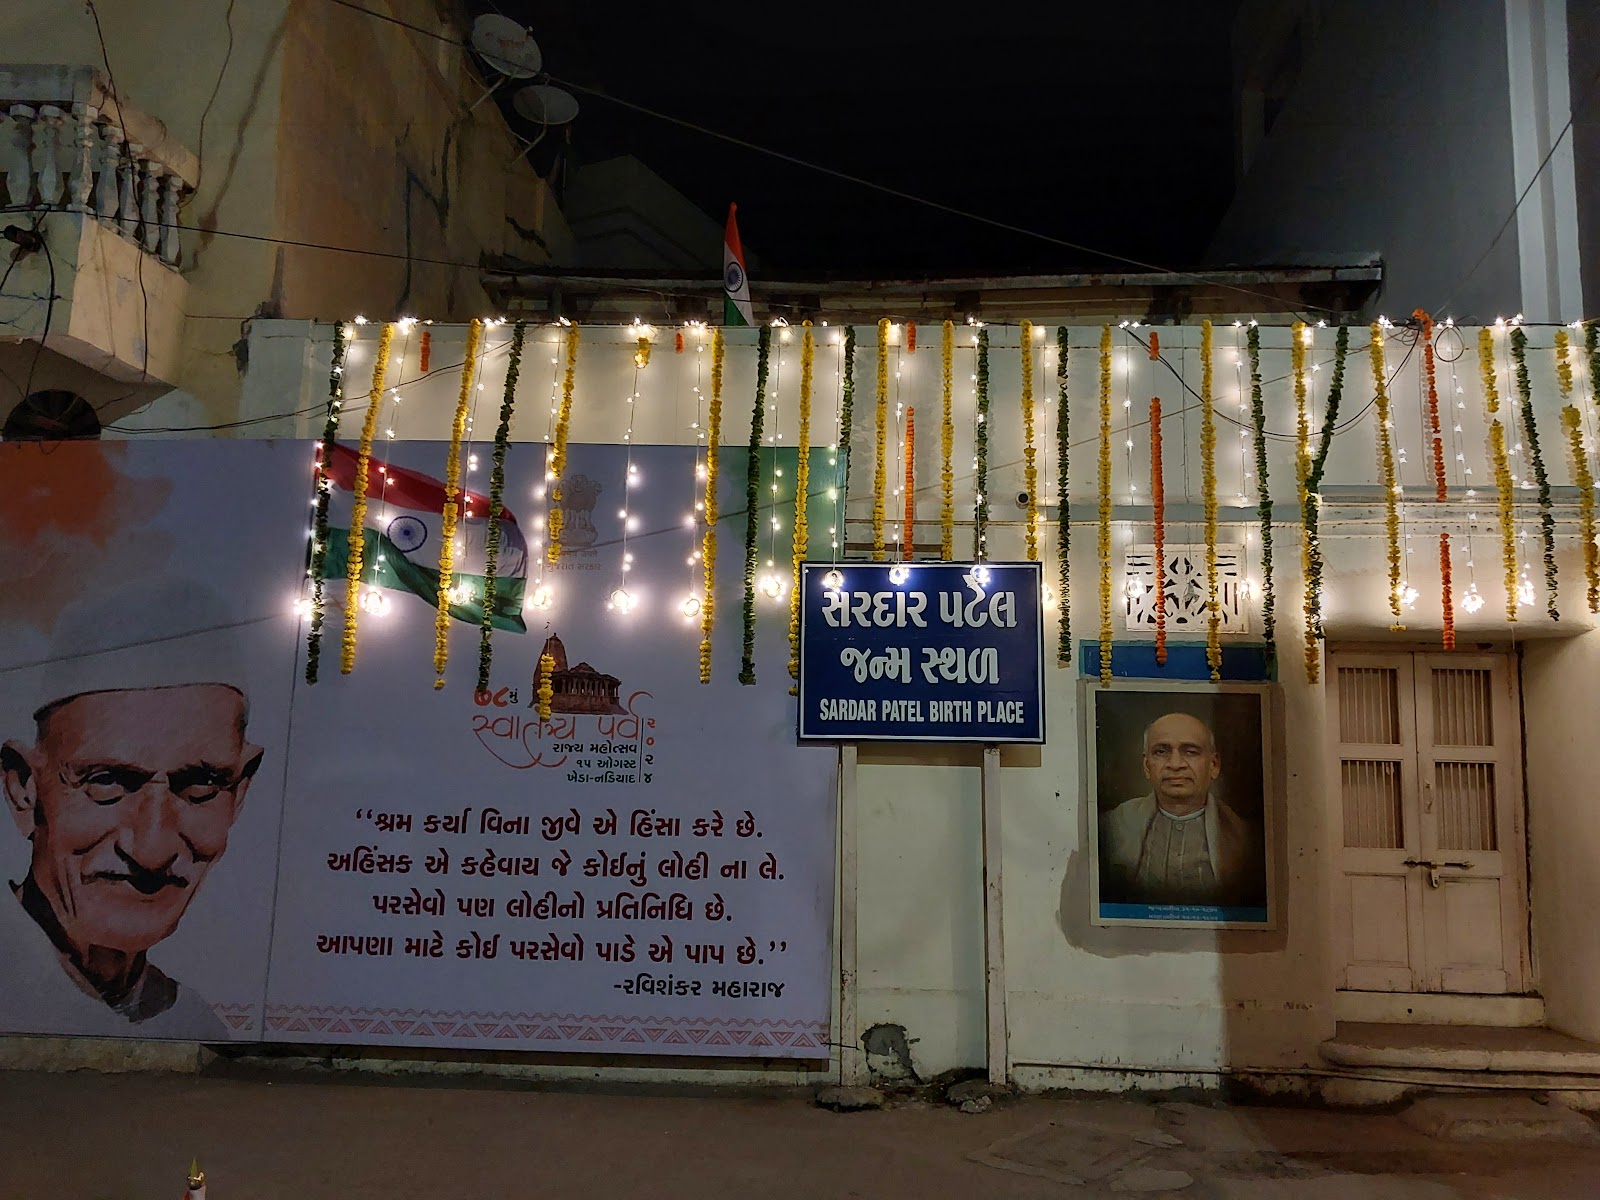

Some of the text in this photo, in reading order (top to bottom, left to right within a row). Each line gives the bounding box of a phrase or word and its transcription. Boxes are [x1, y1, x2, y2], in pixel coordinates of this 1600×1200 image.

[821, 574, 1018, 628] સરદાર પટેલ
[840, 646, 1000, 684] જન્મ સ્થળ
[819, 698, 1025, 724] SARDAR PATEL BIRTH PLACE
[552, 740, 637, 754] રાજ્ય મહોત્સવ
[576, 756, 637, 769] ૧૫ ઓગસ્ટ
[567, 770, 636, 784] ખેડા-નડિયાદ
[423, 808, 472, 834] કર્યા
[480, 808, 529, 835] વિના
[542, 808, 581, 841] જીવે
[593, 808, 617, 836] એ
[630, 809, 680, 838] હિંસા
[692, 810, 724, 837] કરે
[736, 811, 763, 838] છે.
[327, 845, 785, 887] અહિંસક એ કહેવાય જે કોઈનું લોહી ના લે.
[373, 888, 732, 922] પરસેવો પણ લોહીનો પ્રતિનિધિ છે.
[316, 934, 393, 956] આપણા
[405, 930, 444, 958] માટે
[456, 931, 500, 959] કોઈ
[510, 932, 584, 961] પરસેવો
[596, 934, 636, 963] પાડે
[648, 935, 673, 963] એ
[685, 943, 724, 965] પાપ
[712, 980, 785, 998] મહારાજ
